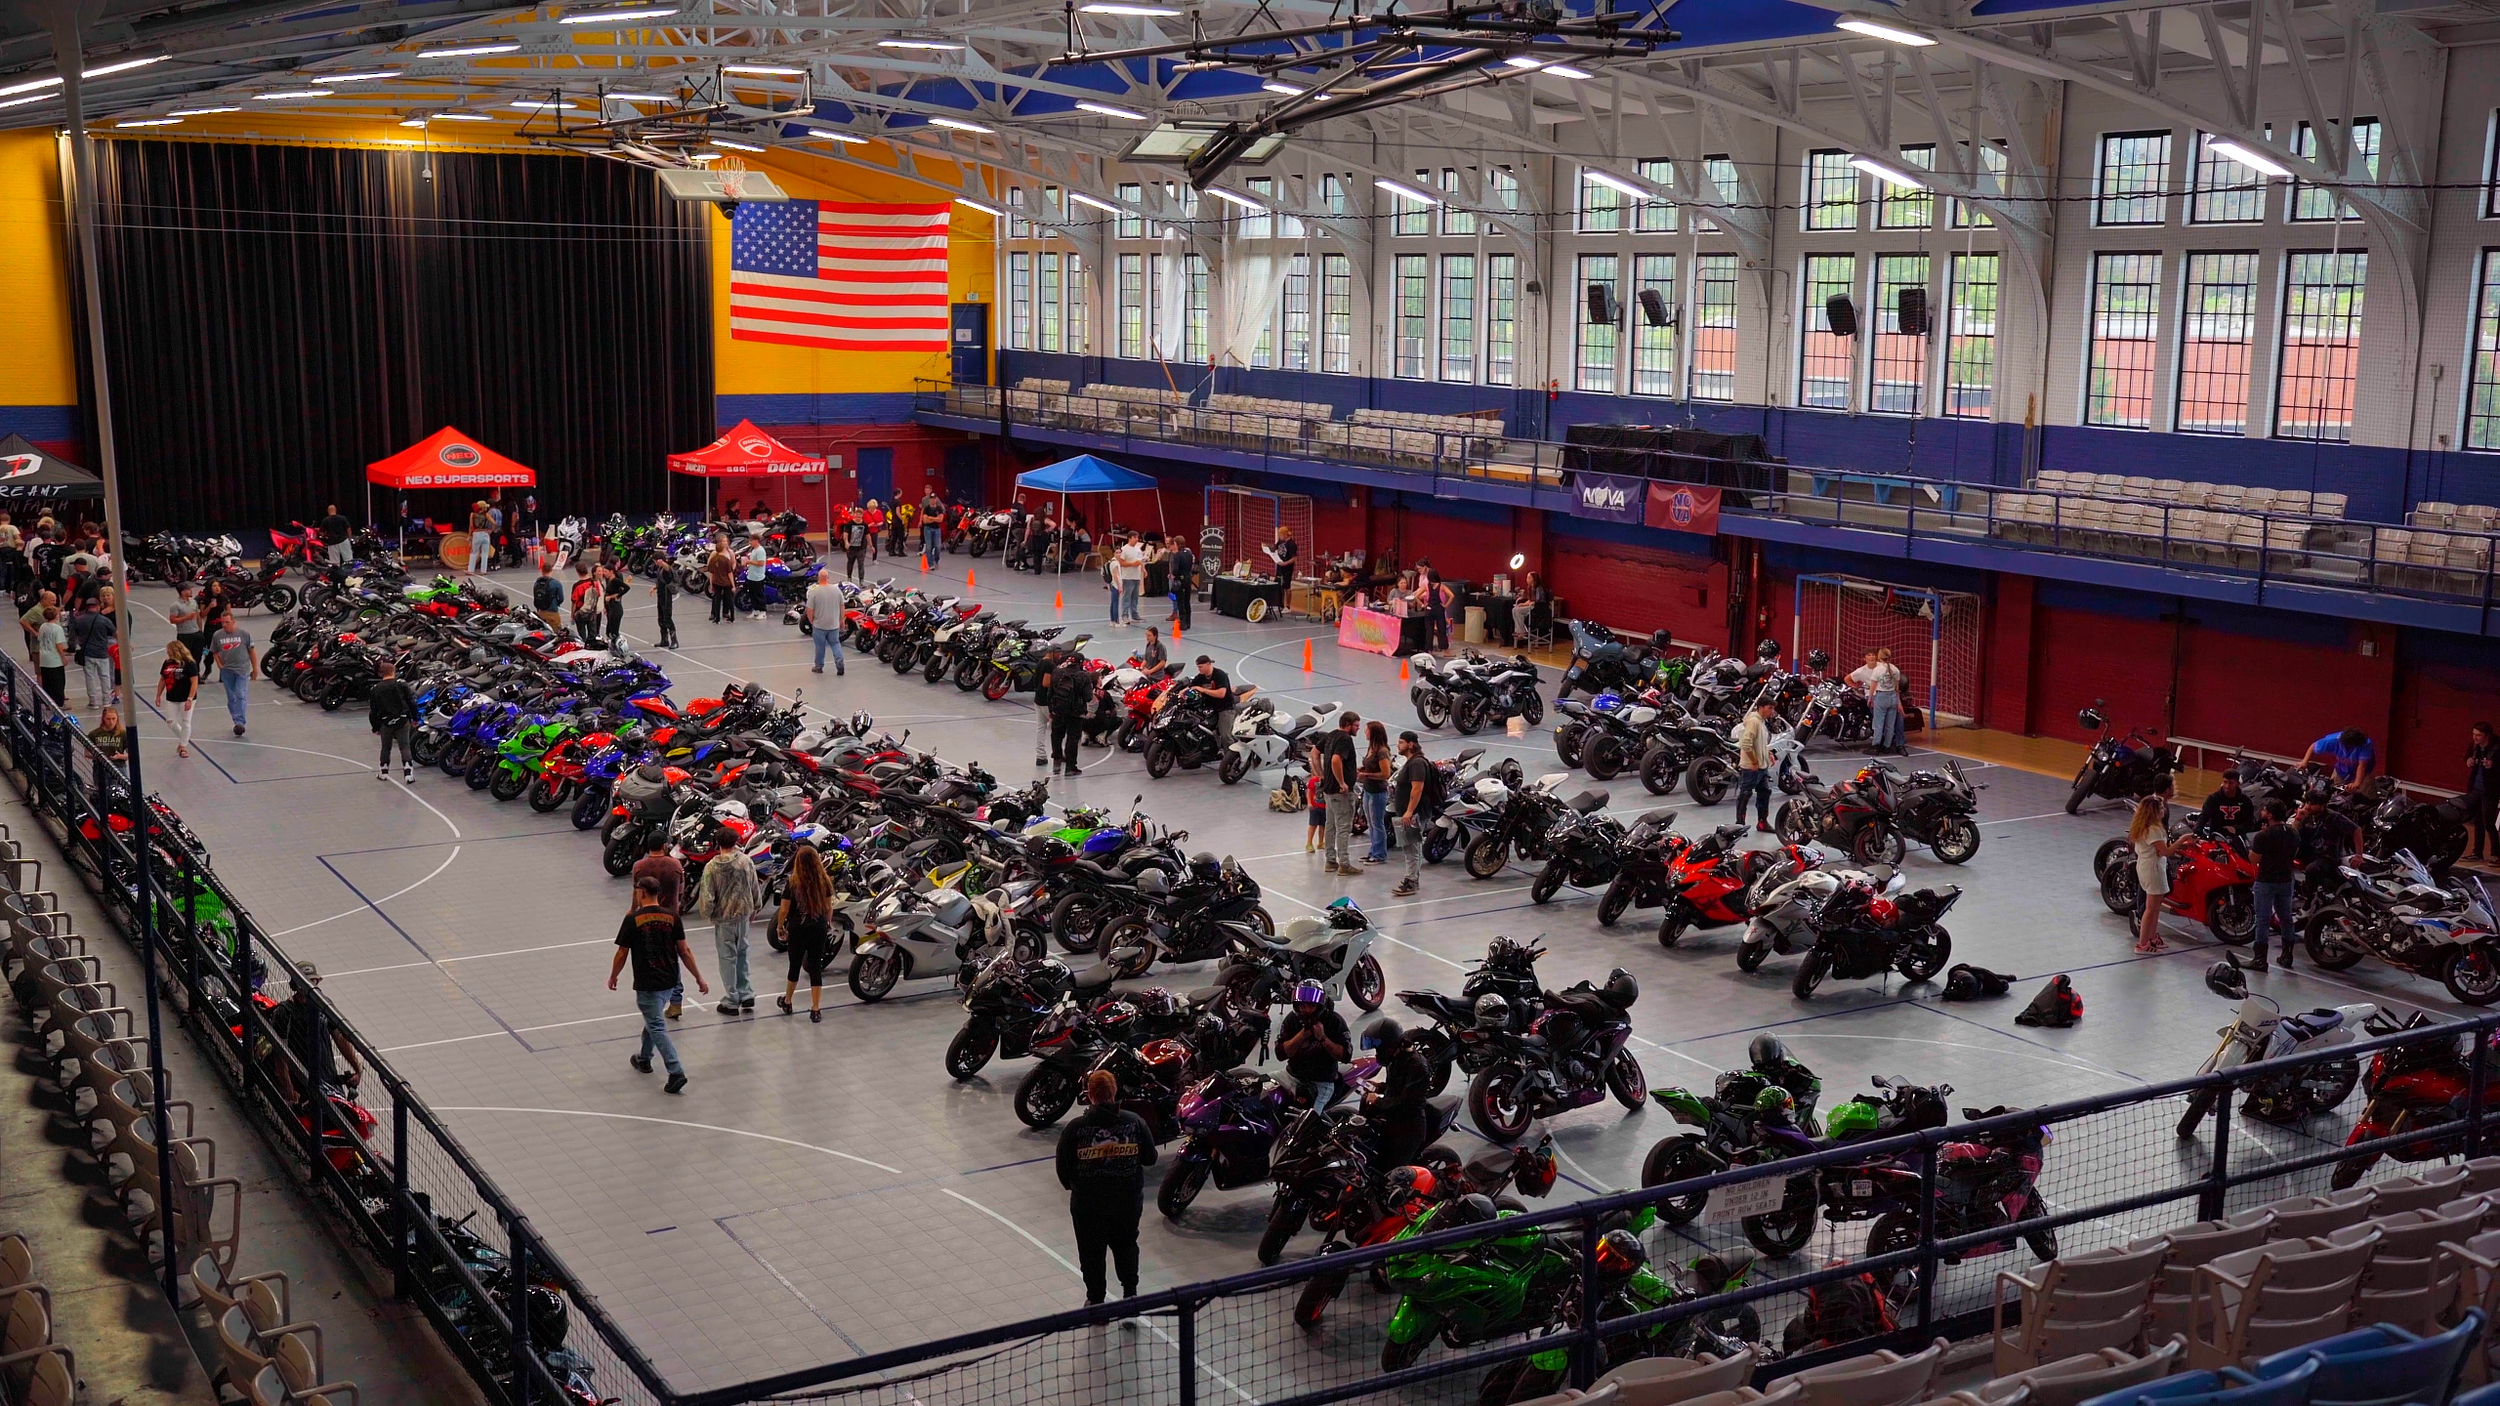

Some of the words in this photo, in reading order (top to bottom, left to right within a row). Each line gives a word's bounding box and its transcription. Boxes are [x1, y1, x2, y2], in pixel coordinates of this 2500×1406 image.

[445, 452, 474, 460] NEO
[766, 462, 826, 473] DUCATI
[405, 476, 432, 485] NEO
[434, 474, 529, 484] SUPERSPORTS
[219, 636, 242, 644] YAMAHA
[2220, 806, 2240, 819] Y
[1725, 1186, 1736, 1194] NO
[1737, 1178, 1771, 1192] CHILDREN
[1724, 1195, 1747, 1206] UNDER
[1760, 1190, 1768, 1199] IN
[1712, 1209, 1736, 1220] FRONT
[1738, 1205, 1753, 1214] ROW
[1755, 1199, 1777, 1211] SEATS
